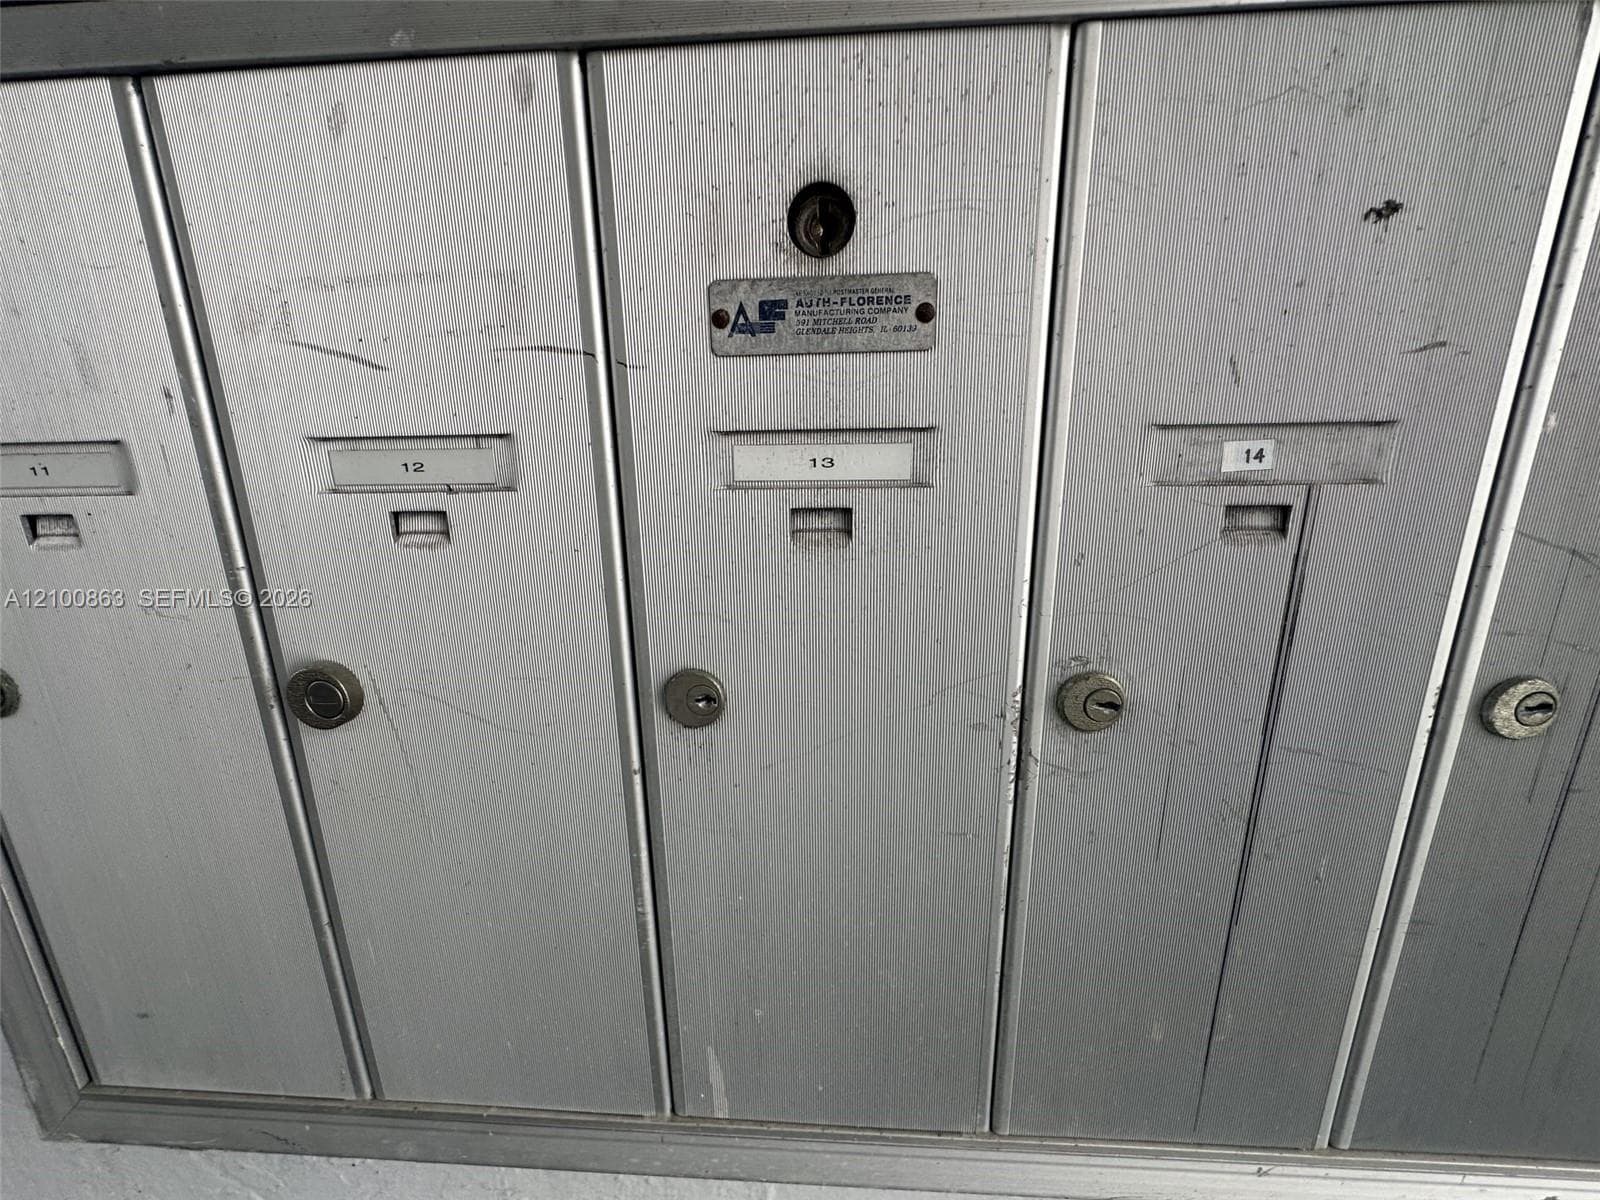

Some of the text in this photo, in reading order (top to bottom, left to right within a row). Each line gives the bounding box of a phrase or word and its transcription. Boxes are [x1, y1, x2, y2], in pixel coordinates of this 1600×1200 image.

[795, 295, 912, 309] AUTH-FLORENCE
[794, 306, 909, 317] MANUFACTURING COMPANY
[812, 317, 853, 326] MITCHELL
[855, 316, 878, 325] ROAD
[795, 327, 837, 336] GLENDALE
[880, 325, 888, 333] IL
[1244, 447, 1266, 464] 14
[401, 462, 425, 473] 12
[809, 457, 835, 468] 13
[29, 466, 49, 476] 11
